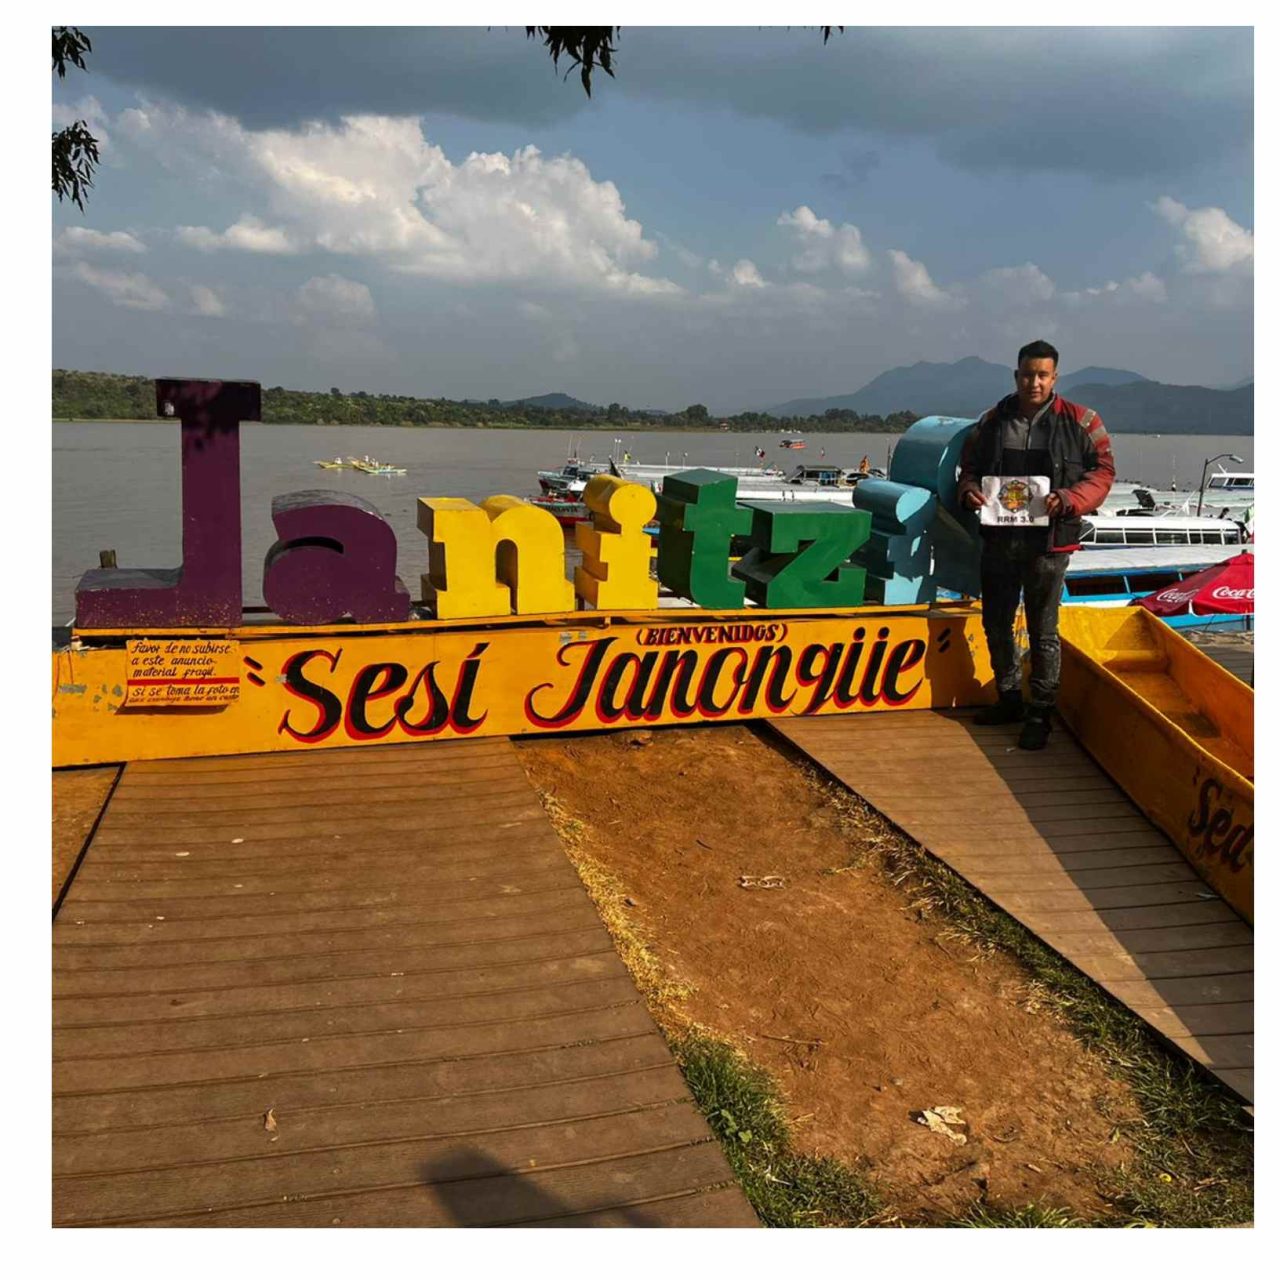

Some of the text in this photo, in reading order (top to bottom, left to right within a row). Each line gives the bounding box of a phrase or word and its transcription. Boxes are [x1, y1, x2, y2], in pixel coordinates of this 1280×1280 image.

[192, 641, 231, 654] subirse
[131, 656, 139, 666] a
[143, 655, 164, 666] este
[133, 666, 177, 677] material
[148, 687, 163, 696] se
[166, 683, 191, 695] toma
[194, 684, 205, 695] la
[206, 684, 228, 695] foto
